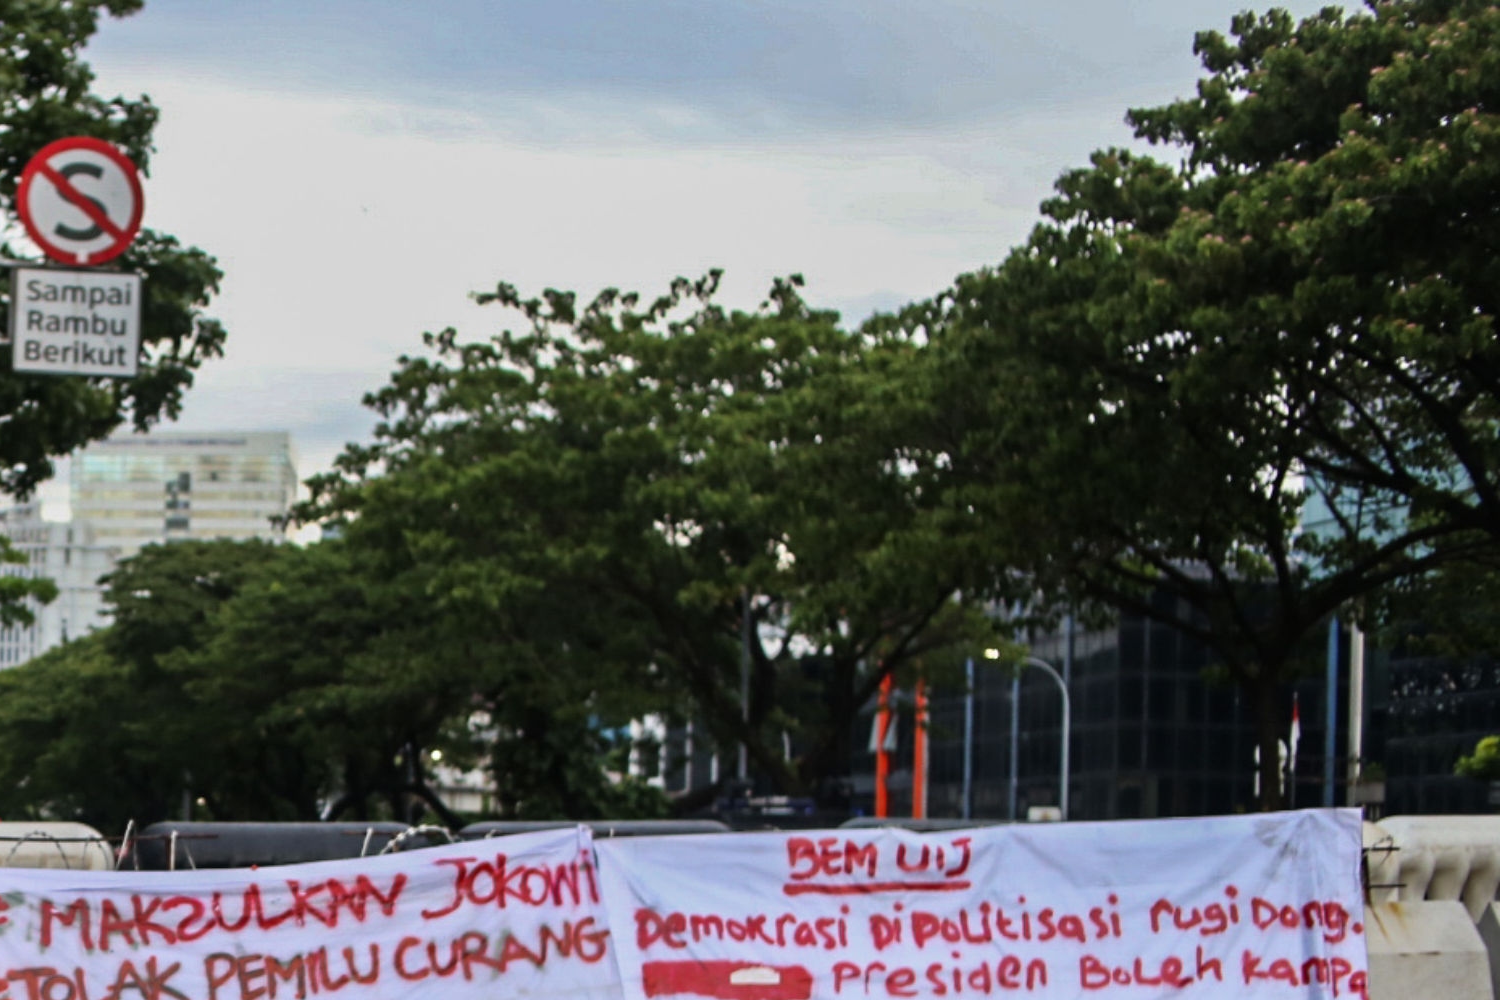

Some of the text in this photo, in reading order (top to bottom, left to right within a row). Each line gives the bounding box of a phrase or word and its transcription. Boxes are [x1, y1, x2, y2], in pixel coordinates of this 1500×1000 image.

[26, 280, 132, 309] Sampai
[26, 310, 127, 336] Rambu
[23, 341, 127, 366] Berikut
[787, 838, 877, 879] BEM
[394, 916, 611, 982] CURANG
